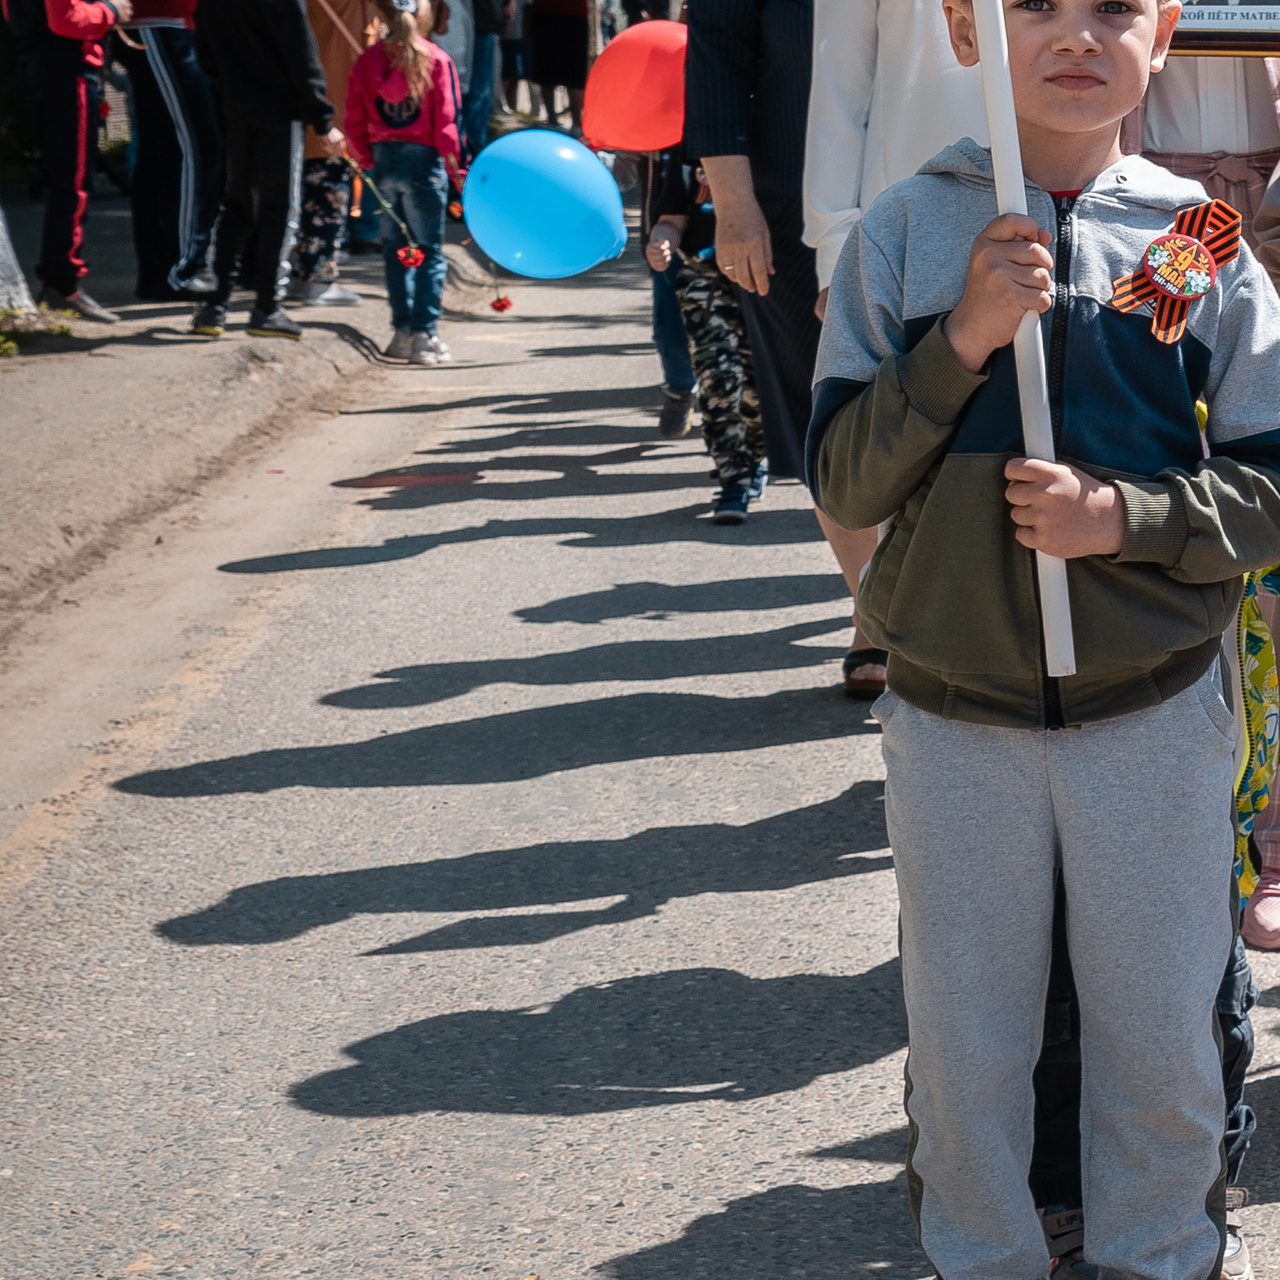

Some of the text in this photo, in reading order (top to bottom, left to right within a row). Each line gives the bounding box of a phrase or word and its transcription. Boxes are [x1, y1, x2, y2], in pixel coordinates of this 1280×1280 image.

[1180, 11, 1204, 21] КОЙ
[1208, 10, 1237, 21] ПЁТР
[1174, 252, 1192, 271] 9
[1157, 264, 1186, 289] МАЯ
